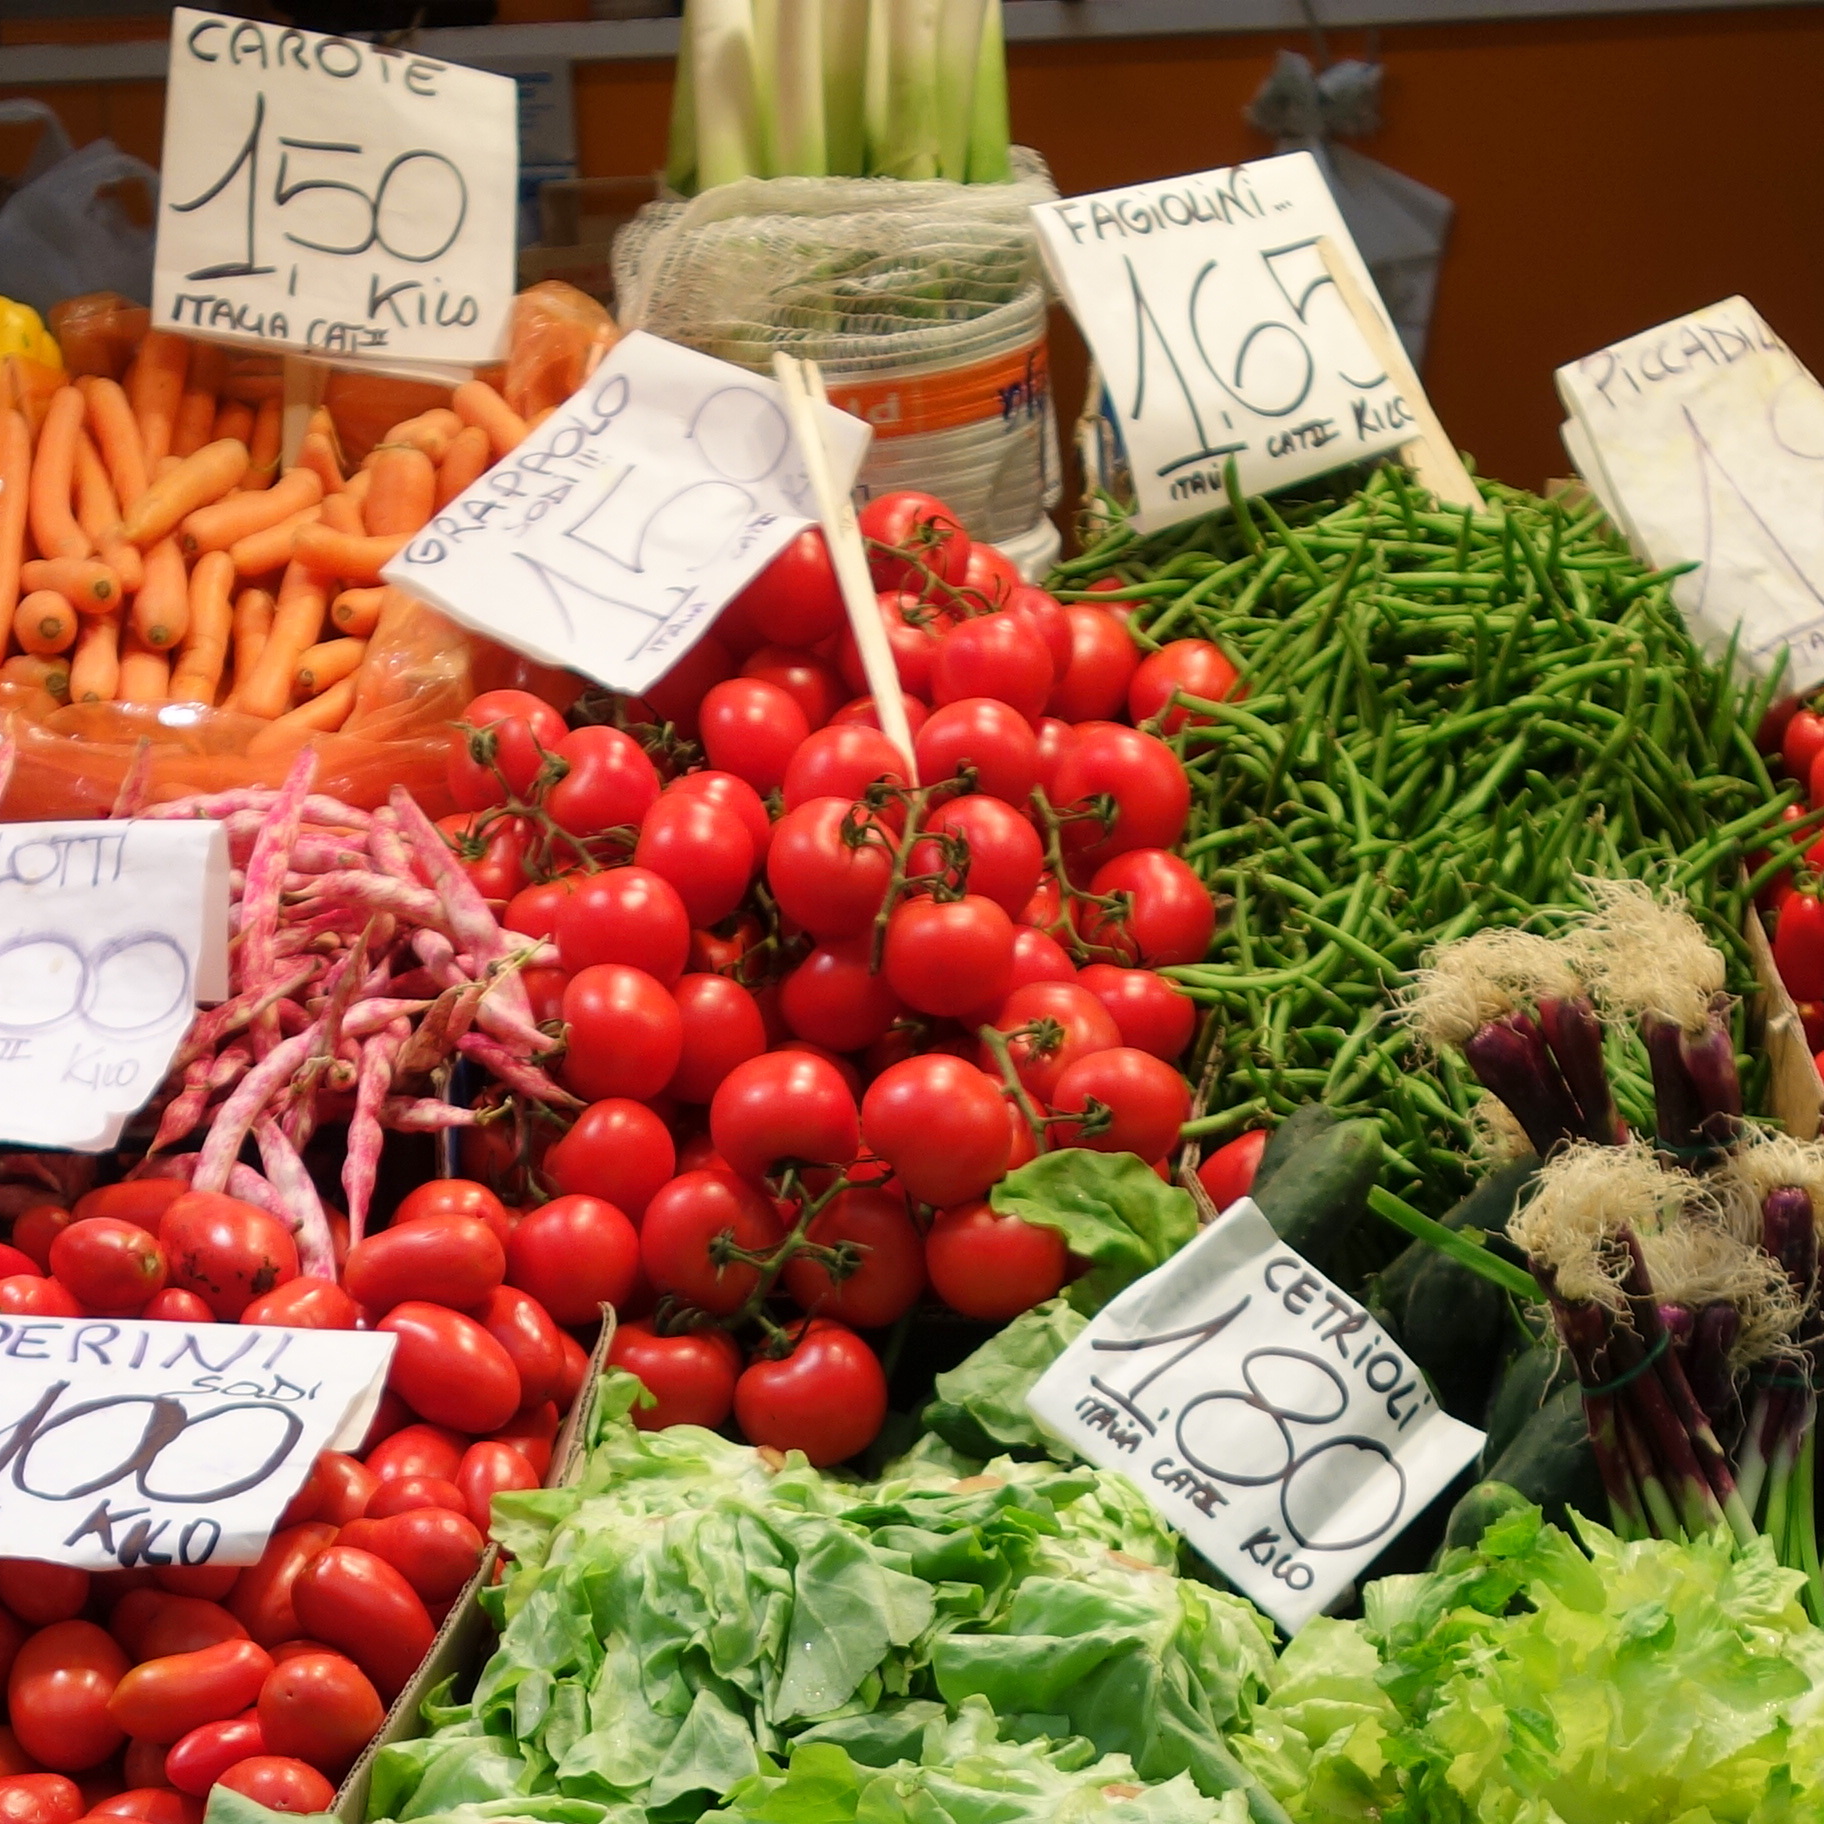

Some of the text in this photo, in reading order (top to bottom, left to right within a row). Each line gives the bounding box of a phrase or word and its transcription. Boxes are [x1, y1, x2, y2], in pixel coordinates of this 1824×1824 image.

[187, 18, 446, 97] CAROTE
[171, 292, 289, 339] ITALIA
[404, 372, 631, 566] GRAPPOLO
[60, 1042, 141, 1092] KILO
[1263, 1254, 1432, 1434] CETRIOLI
[1240, 1525, 1315, 1592] KILO
